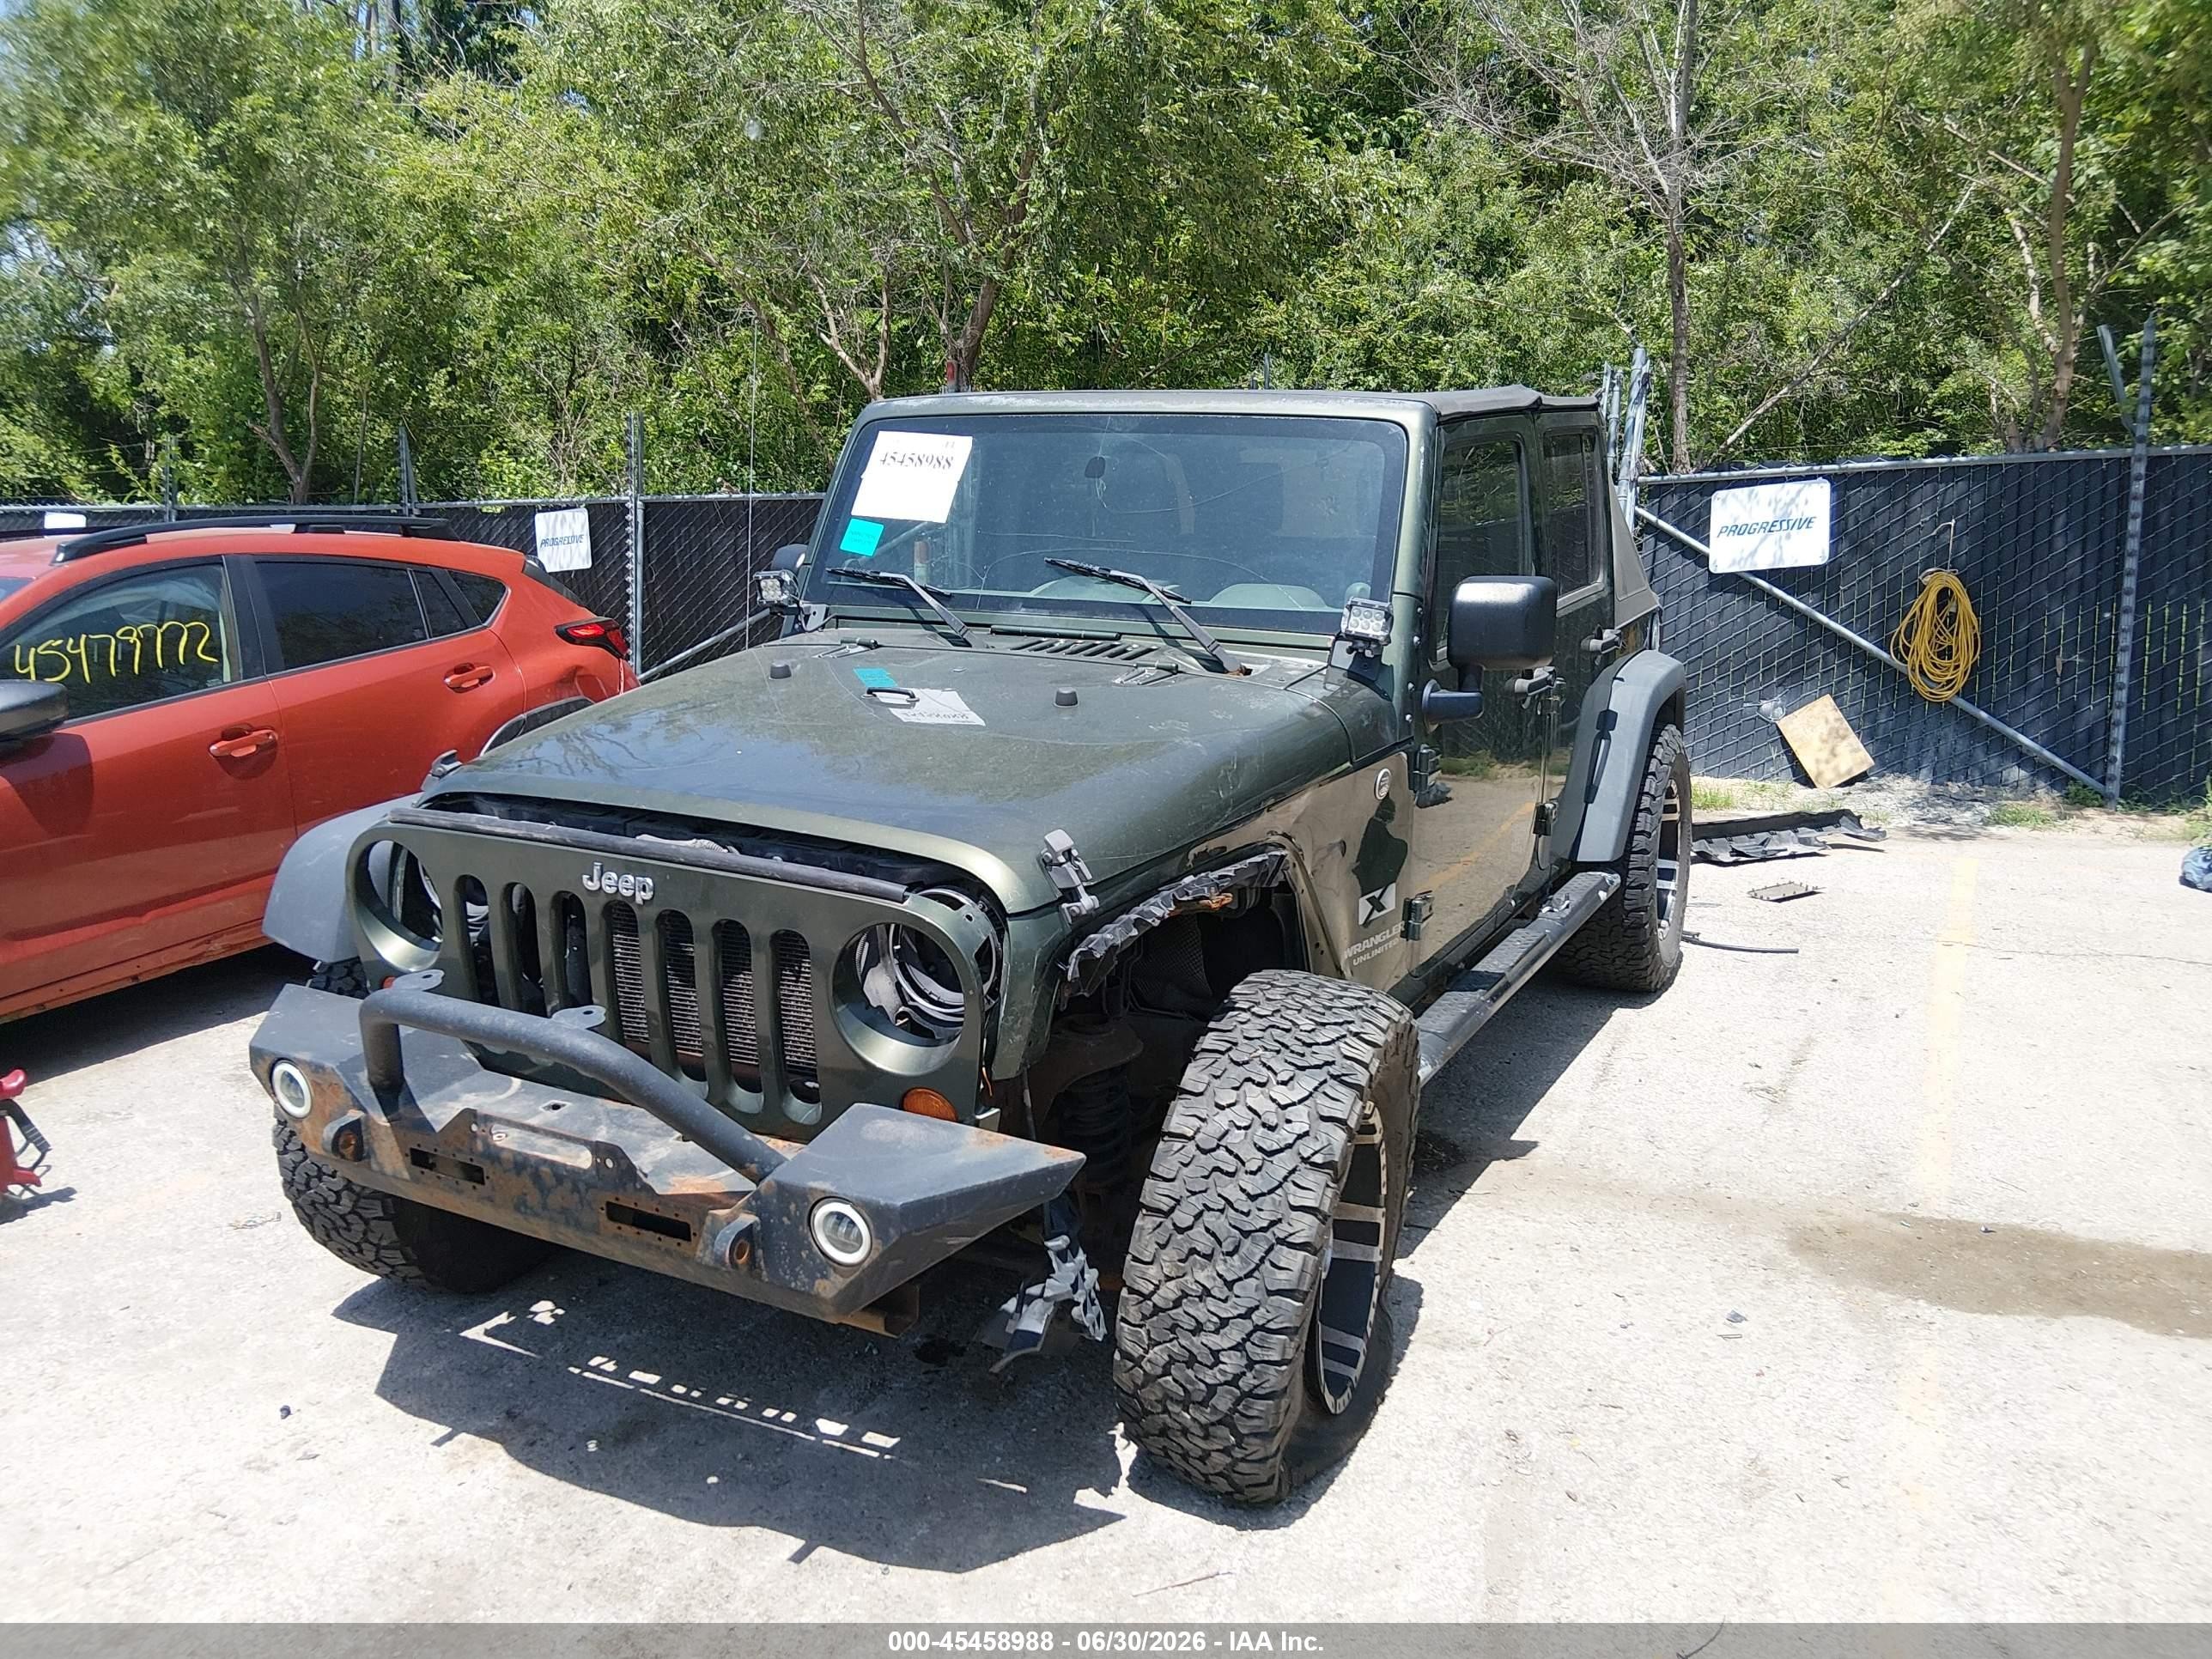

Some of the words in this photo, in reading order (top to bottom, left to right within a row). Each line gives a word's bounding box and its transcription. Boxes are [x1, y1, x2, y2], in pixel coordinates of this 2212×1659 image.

[880, 451, 954, 470] 45458988
[1717, 517, 1817, 538] PROGRESSIVE
[15, 621, 219, 684] 45479772
[582, 861, 653, 905] Jeep
[1345, 921, 1405, 959] WRANGLER
